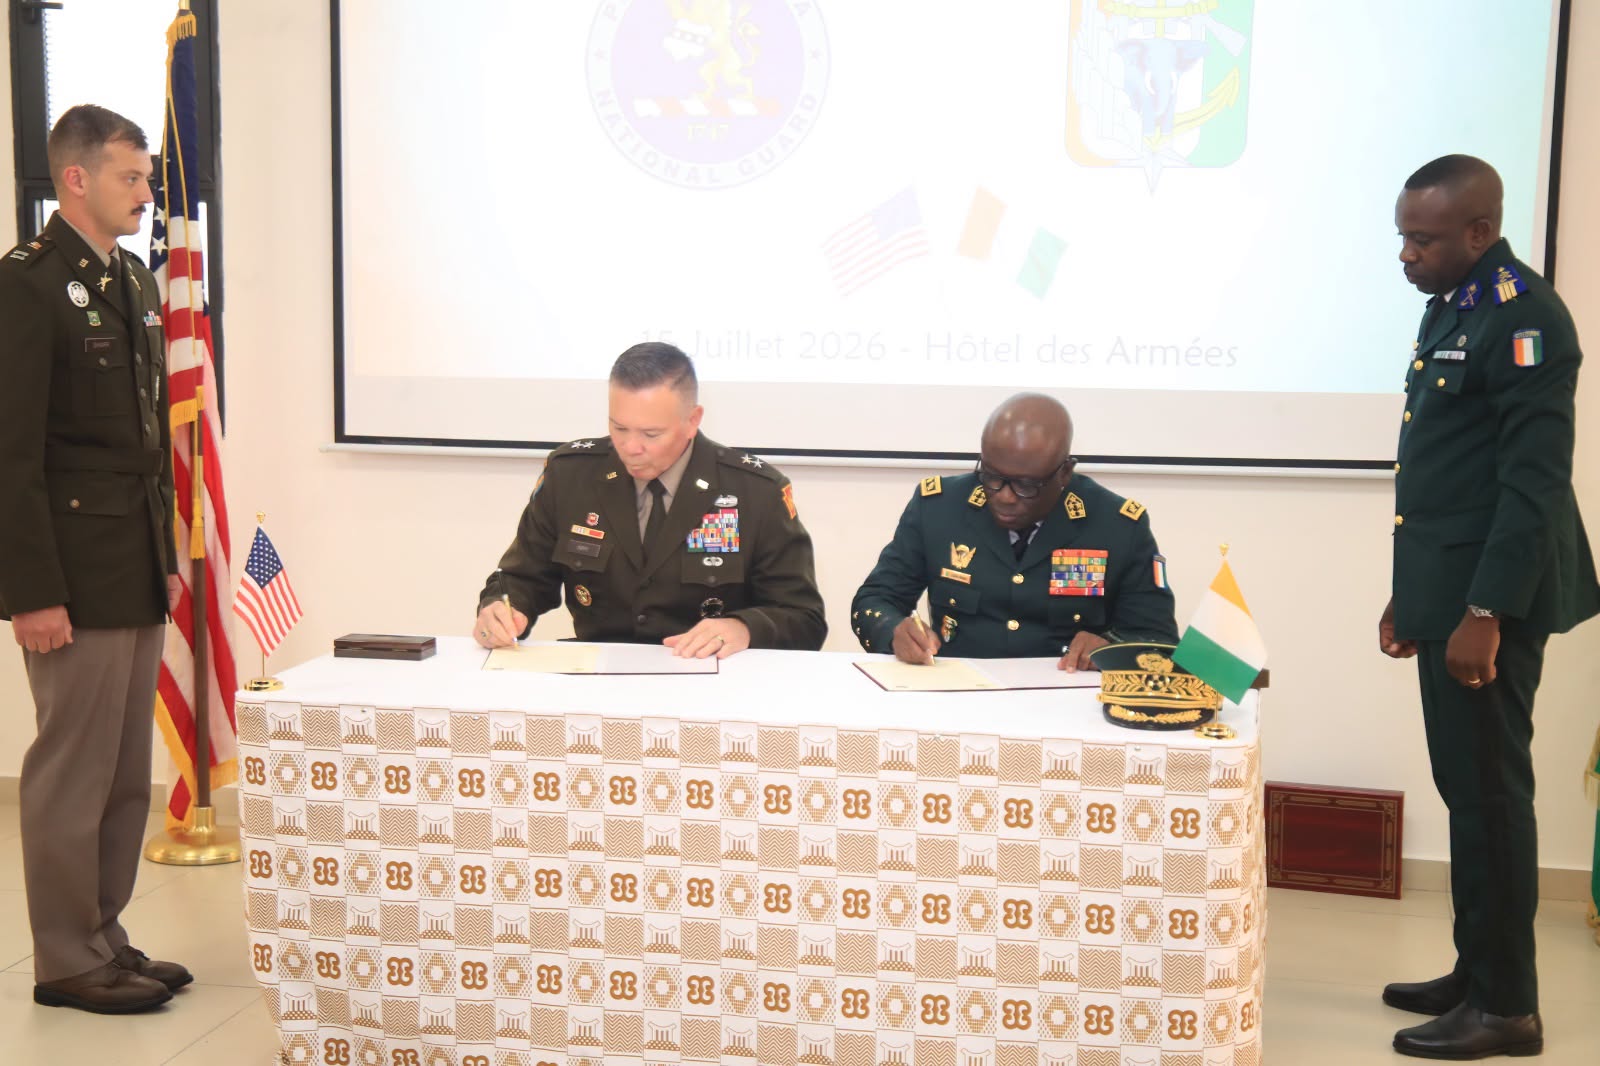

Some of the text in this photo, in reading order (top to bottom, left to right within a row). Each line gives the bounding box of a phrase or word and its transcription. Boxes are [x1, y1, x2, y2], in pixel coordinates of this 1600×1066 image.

[596, 89, 817, 184] NATIONAL GUARD
[689, 328, 785, 360] Juillet
[799, 330, 886, 361] 2026
[926, 330, 1022, 363] Hôtel
[1036, 333, 1093, 364] des
[1105, 335, 1239, 368] Armées
